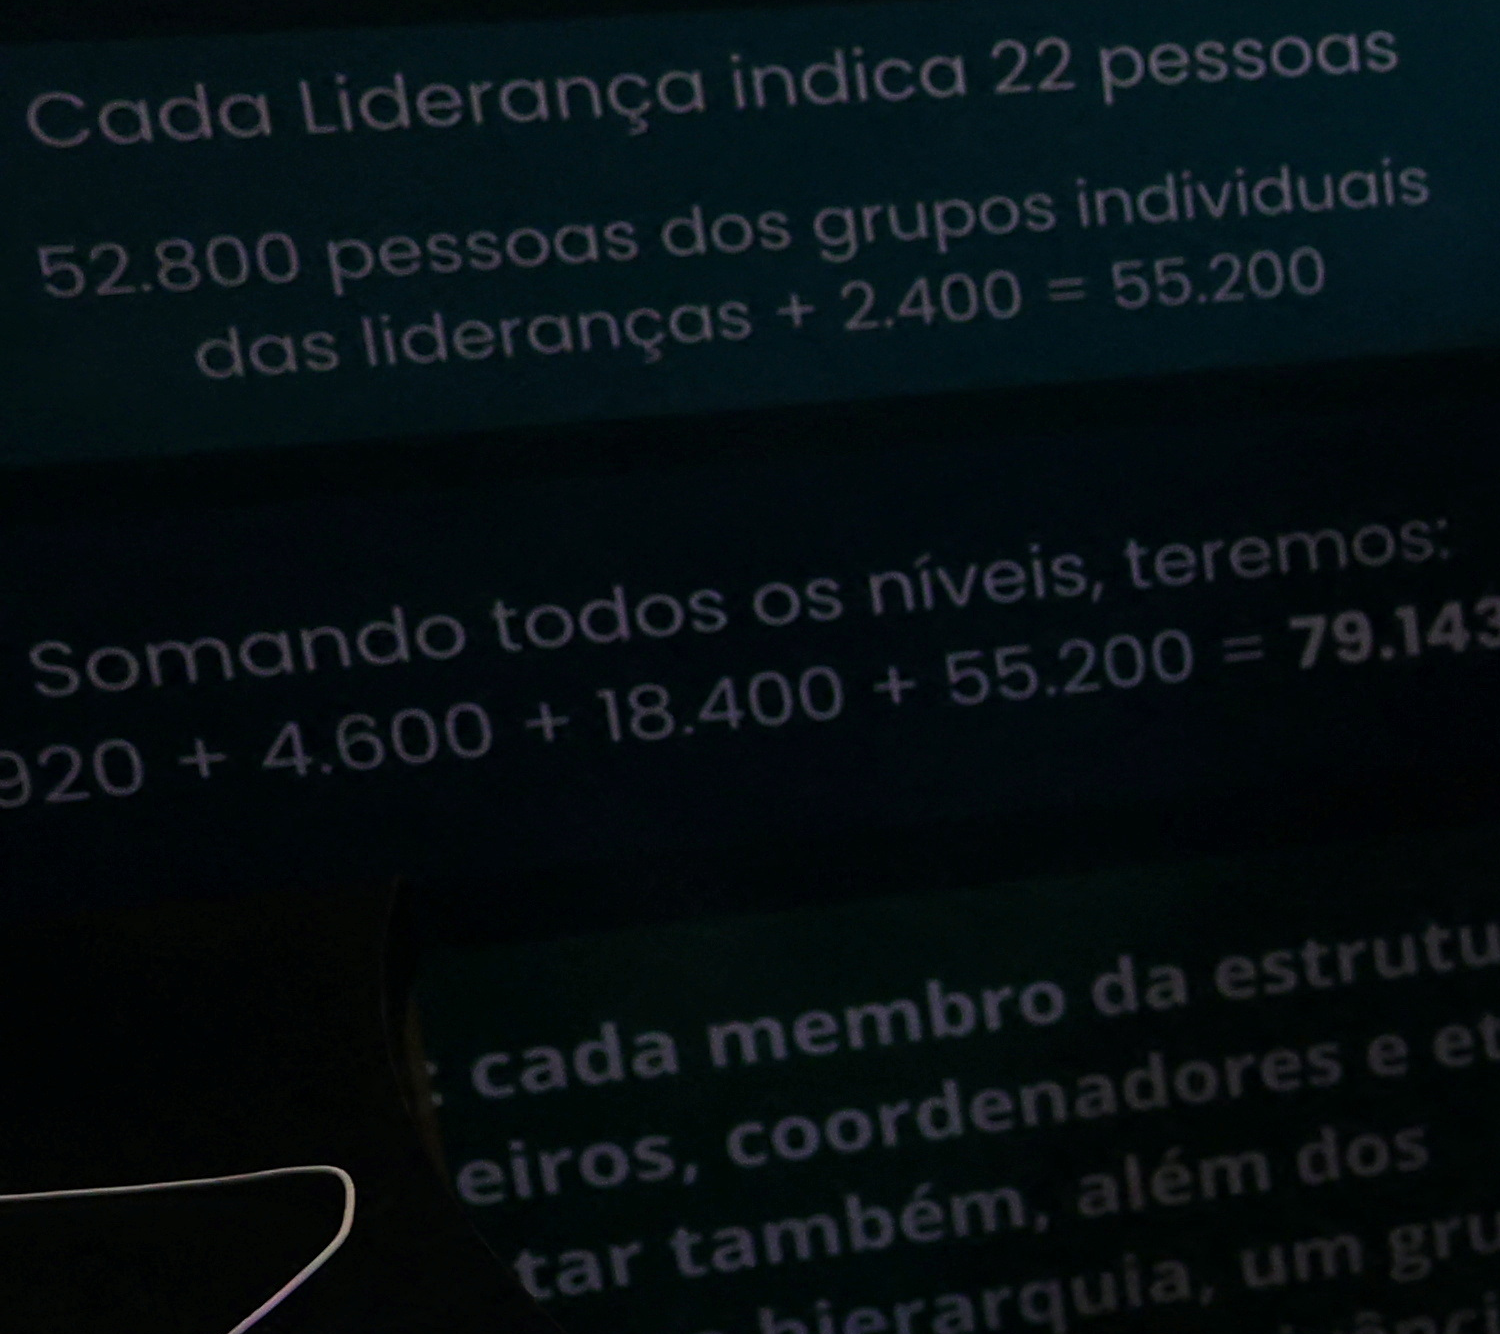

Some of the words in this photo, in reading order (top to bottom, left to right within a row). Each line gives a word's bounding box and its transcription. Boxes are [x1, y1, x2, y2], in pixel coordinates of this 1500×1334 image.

[26, 81, 273, 150] Cada
[300, 71, 707, 136] Liderança
[730, 47, 968, 111] indica
[990, 37, 1076, 95] 22
[1100, 29, 1401, 106] pessoas
[38, 231, 302, 300] 52.800
[328, 219, 640, 298] pessoas
[662, 203, 793, 259] dos
[813, 187, 1056, 263] grupos
[1076, 156, 1431, 229] individuais
[195, 325, 341, 380] das
[360, 297, 754, 366] lideranças
[777, 293, 815, 329] +
[841, 269, 1024, 332] 2.400
[1049, 276, 1088, 303] =
[1111, 246, 1327, 311] 55.200
[28, 604, 468, 699] Somando
[490, 584, 730, 655] todos
[753, 576, 844, 628] os
[869, 543, 1105, 617] níveis,
[1124, 516, 1453, 592] teremos:
[0, 738, 146, 810] 920
[178, 739, 228, 780] +
[261, 701, 494, 781] 4.600
[523, 699, 570, 743] +
[597, 666, 846, 744] 18.400
[874, 666, 916, 706] +
[946, 628, 1195, 708] 55.200
[1220, 634, 1265, 665] =
[470, 1021, 680, 1100] cada
[708, 977, 1067, 1069] membro
[1091, 953, 1189, 1017] da
[455, 1133, 699, 1208] eiros,
[726, 1038, 1344, 1168] coordenadores
[1366, 1033, 1409, 1077] e
[669, 1181, 1049, 1280] também,
[1077, 1145, 1271, 1219] além
[1297, 1124, 1430, 1188] dos
[1239, 1231, 1363, 1290] um
